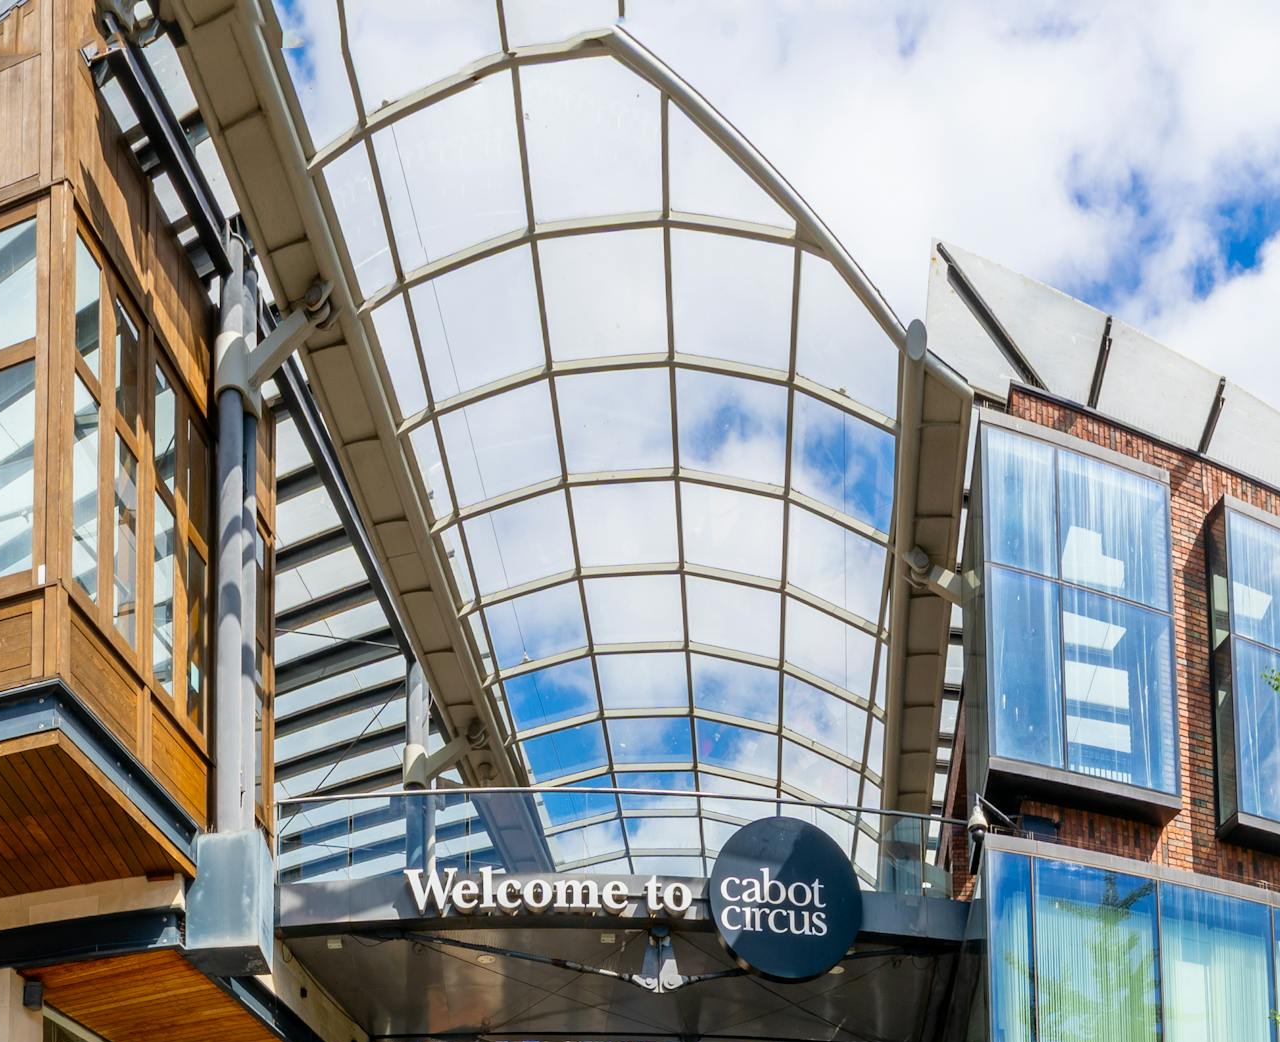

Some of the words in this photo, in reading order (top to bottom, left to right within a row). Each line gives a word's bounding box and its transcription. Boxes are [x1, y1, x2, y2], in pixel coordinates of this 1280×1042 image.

[403, 865, 629, 913] Welcome
[644, 873, 693, 912] to
[720, 867, 827, 908] cabot
[720, 904, 828, 937] circus
